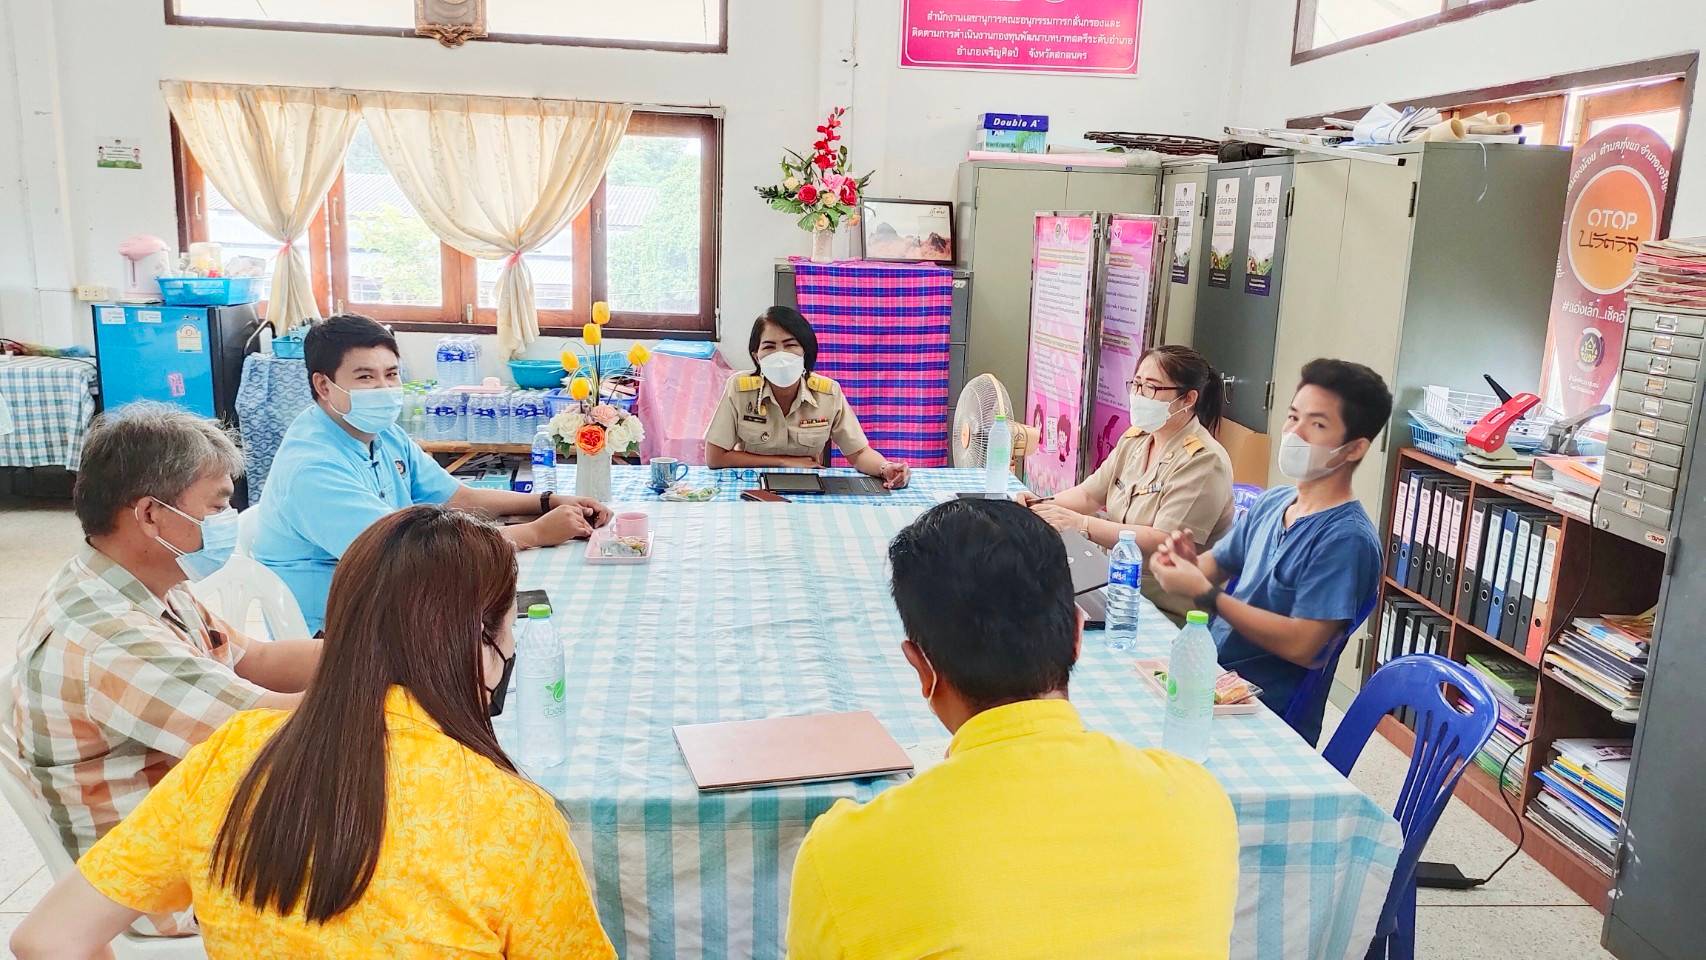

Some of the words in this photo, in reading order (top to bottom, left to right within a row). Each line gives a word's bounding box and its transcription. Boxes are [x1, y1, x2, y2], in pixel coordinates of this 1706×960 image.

[956, 45, 1019, 60] อำเภอเจริญศิลป์
[1028, 47, 1088, 61] จังหวัดสกลนคร
[993, 117, 1027, 127] Double
[1030, 119, 1038, 128] A
[1587, 208, 1638, 230] OTOP
